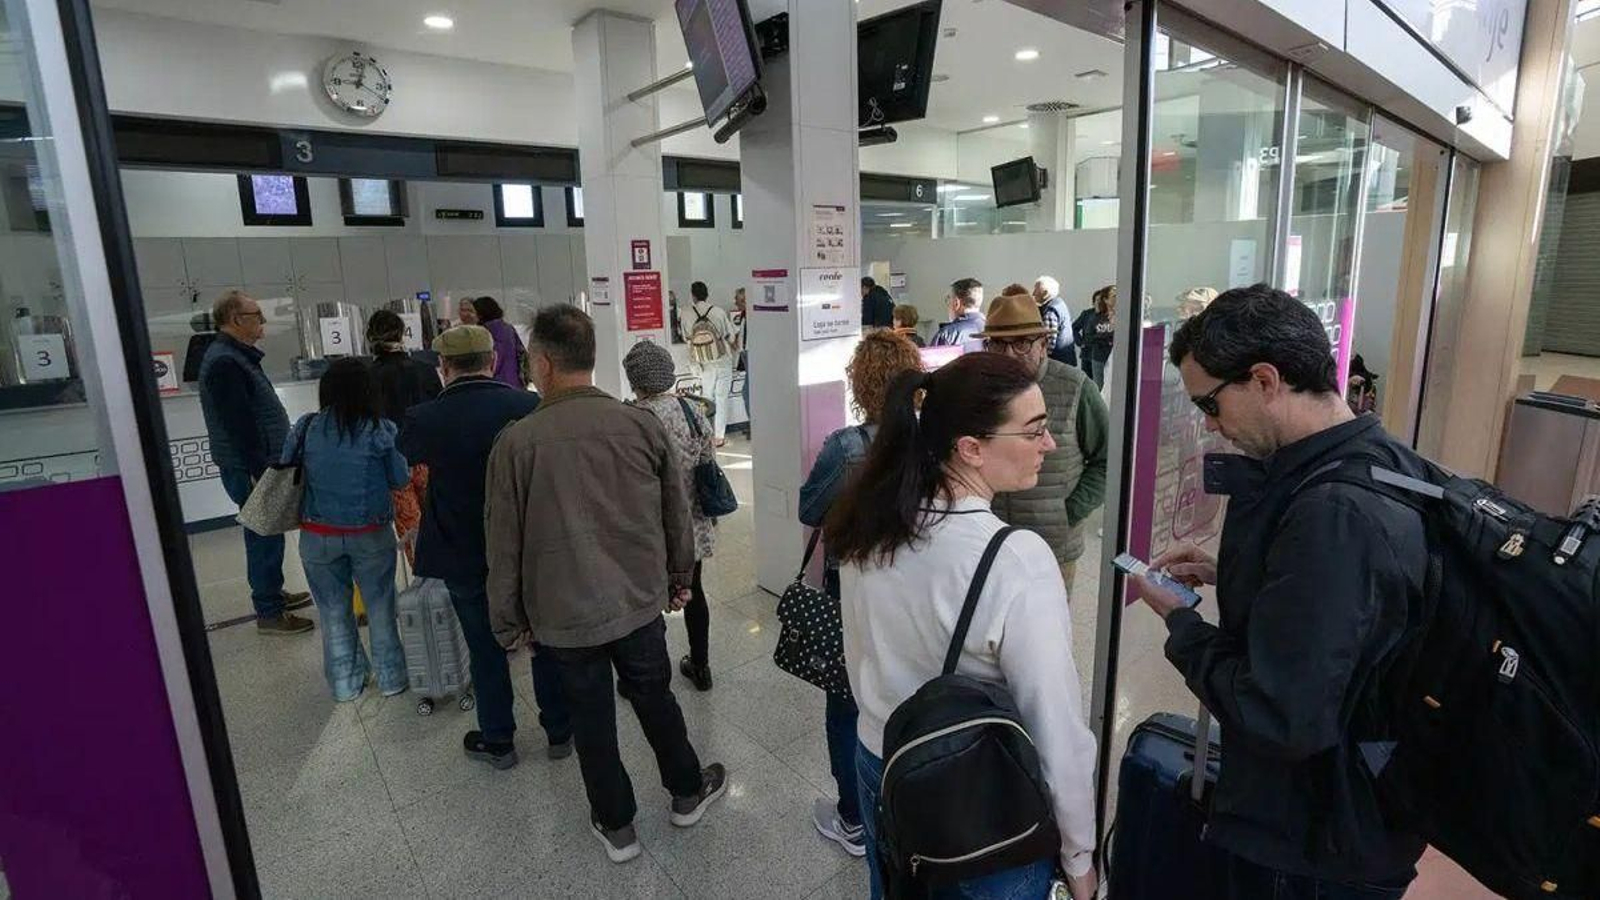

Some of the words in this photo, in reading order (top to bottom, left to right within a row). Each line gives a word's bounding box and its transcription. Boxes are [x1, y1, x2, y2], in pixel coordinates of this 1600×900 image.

[296, 140, 313, 163] 3
[916, 184, 923, 198] 6
[819, 270, 843, 281] renfe
[331, 330, 342, 345] 3
[404, 325, 413, 339] 4
[36, 350, 52, 367] 3
